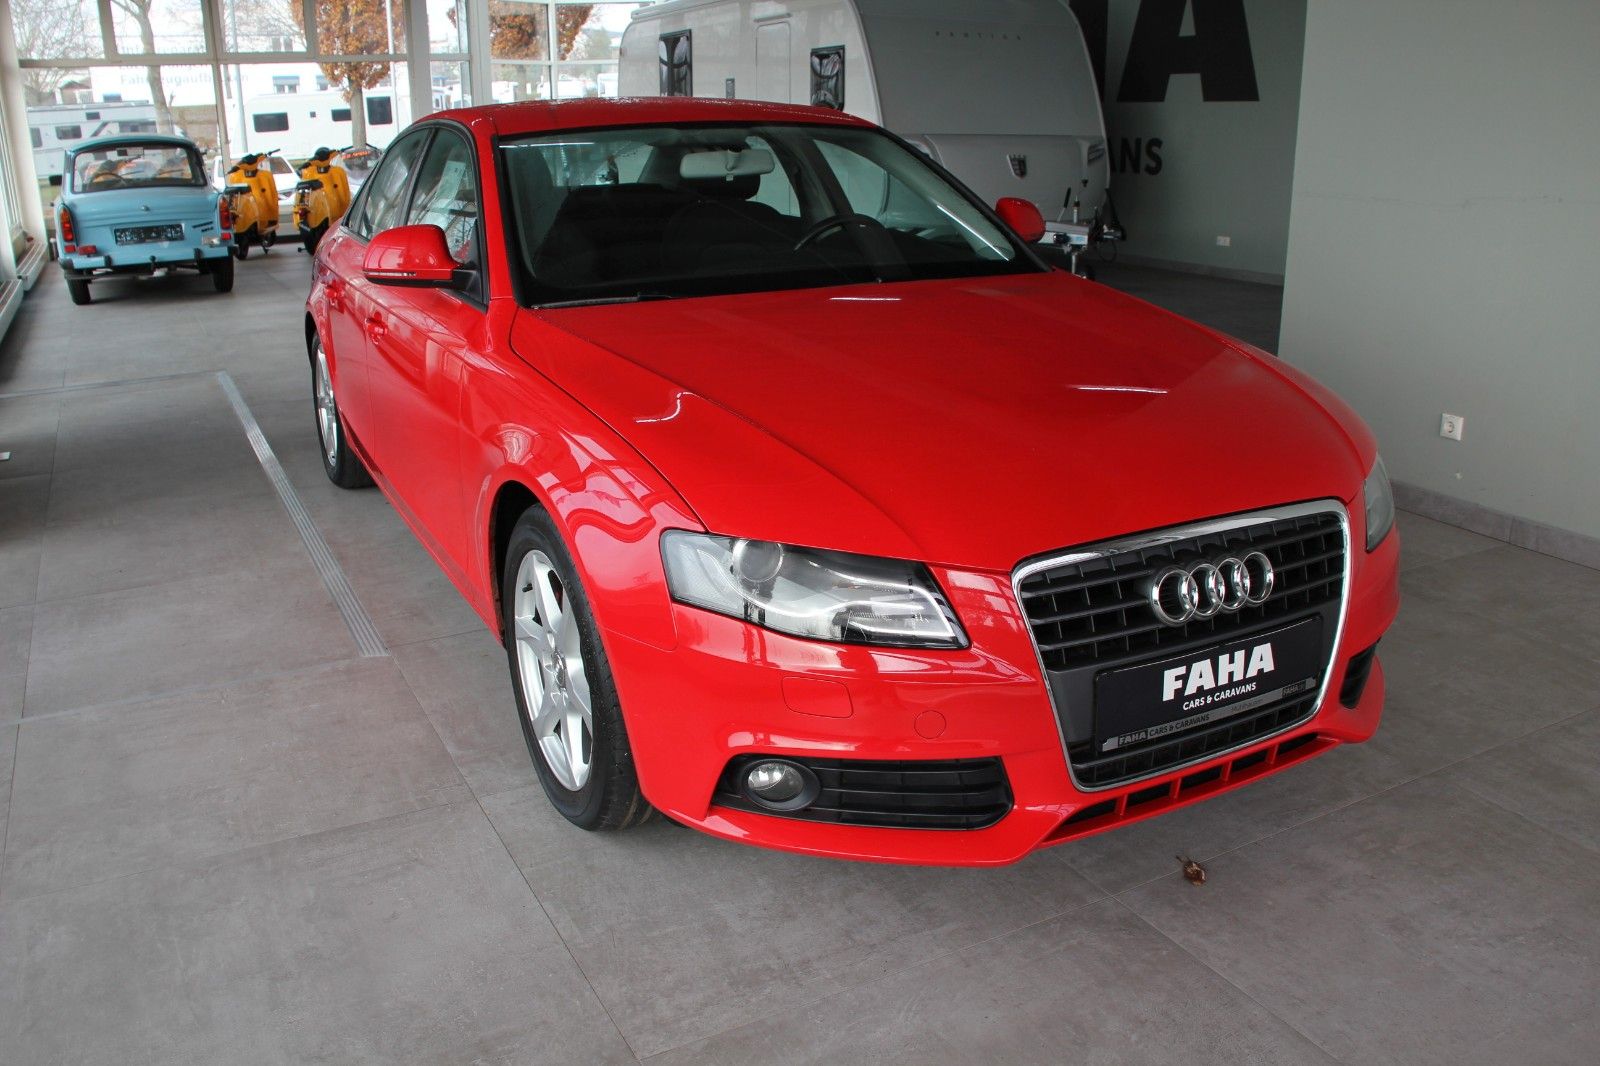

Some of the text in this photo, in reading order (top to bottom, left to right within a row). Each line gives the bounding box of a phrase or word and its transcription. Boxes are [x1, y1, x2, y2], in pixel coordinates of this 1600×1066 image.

[1162, 642, 1275, 701] FAHA
[1182, 682, 1257, 711] CARS & CARAVANS
[1118, 731, 1147, 746] FAHA
[1149, 724, 1168, 738] CARS
[1175, 713, 1210, 731] CARAVANS
